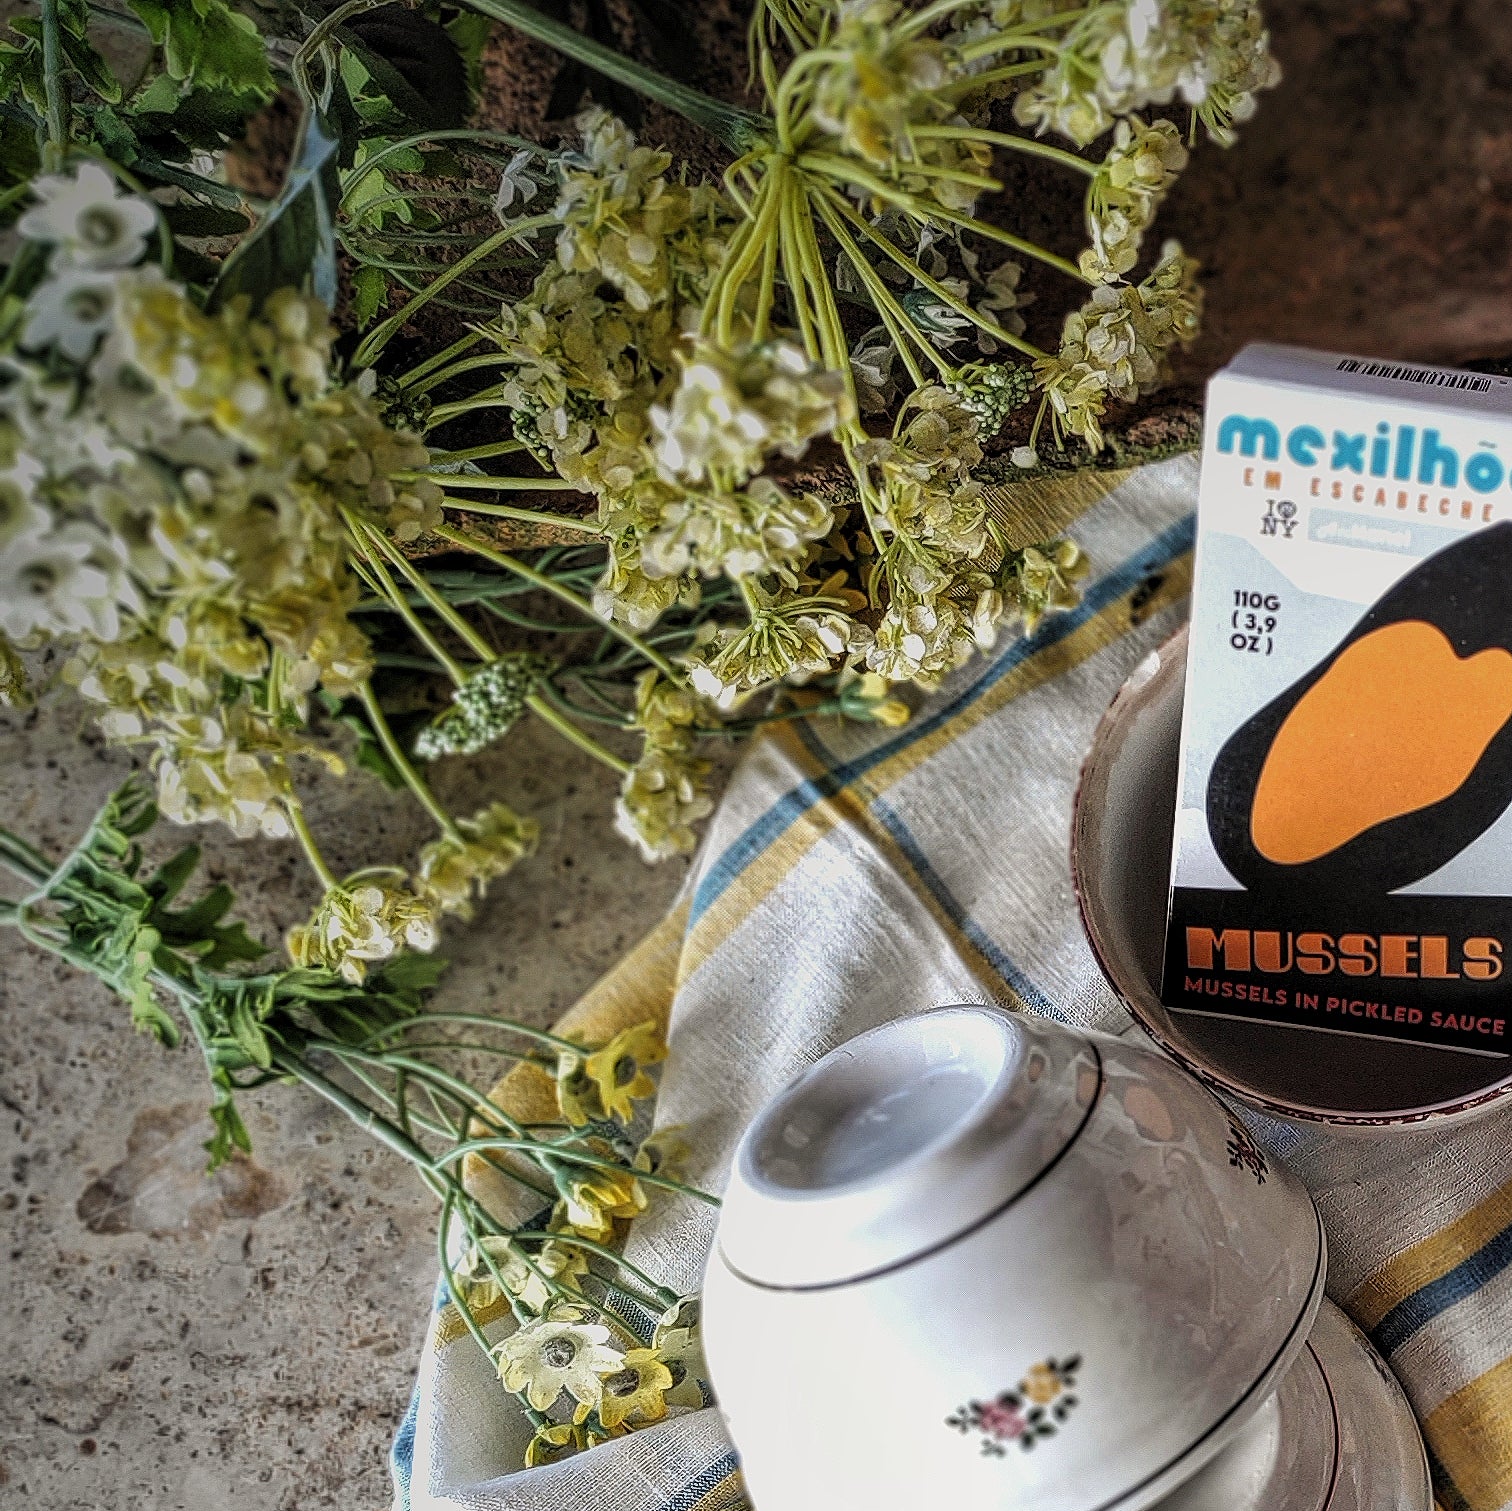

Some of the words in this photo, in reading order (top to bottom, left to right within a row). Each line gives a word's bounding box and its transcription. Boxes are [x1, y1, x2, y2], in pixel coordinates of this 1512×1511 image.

[1243, 467, 1282, 490] EM
[1310, 481, 1494, 523] ESCABECHE
[1260, 516, 1300, 538] NY
[1233, 589, 1281, 611] 110G
[1185, 926, 1504, 982] MUSSELS
[1183, 976, 1288, 1006] MUSSELS
[1295, 991, 1319, 1010] IN
[1326, 997, 1424, 1026] PICKLED
[1430, 1011, 1506, 1036] SAUCE
